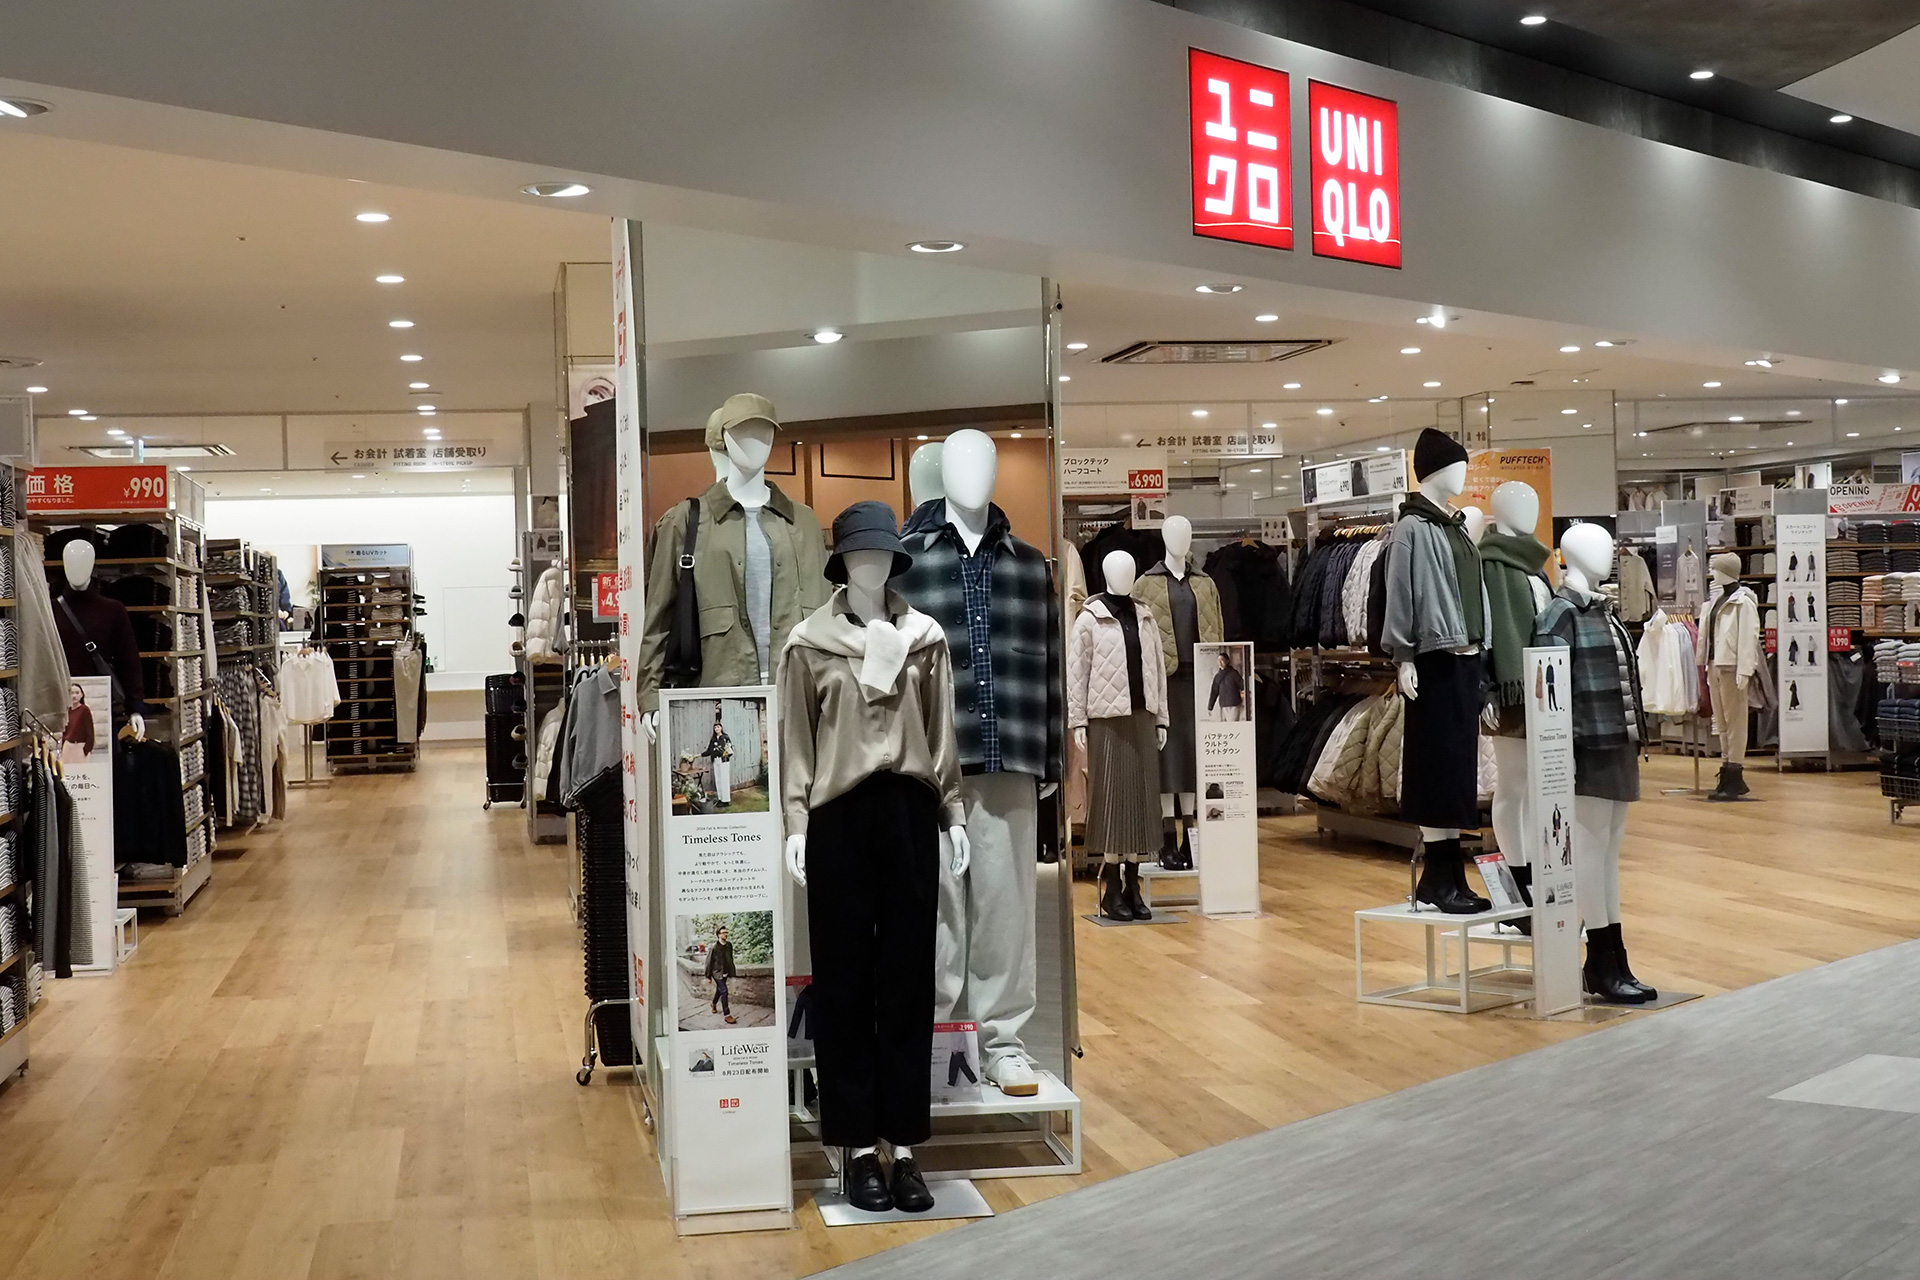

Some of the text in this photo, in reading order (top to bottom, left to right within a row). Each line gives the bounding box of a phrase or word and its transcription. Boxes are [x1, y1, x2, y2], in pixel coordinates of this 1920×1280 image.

[1205, 78, 1277, 150] ユニ
[1320, 107, 1382, 176] UNI
[1205, 155, 1279, 224] クロ
[1322, 178, 1390, 247] QLO
[1157, 436, 1186, 446] お会計
[1192, 436, 1222, 446] 試着室
[354, 446, 486, 459] お会計 試着室 店舗受取り
[1063, 458, 1109, 466] ブロックテック
[1500, 456, 1544, 464] PUFFTECH
[1131, 474, 1161, 488] ¥6,990
[123, 477, 164, 498] ¥990
[1830, 486, 1870, 496] OPENING
[682, 832, 761, 844] Timeless Tones
[721, 1044, 769, 1056] LifeWear
[722, 1068, 769, 1076] 8月23日配布開始
